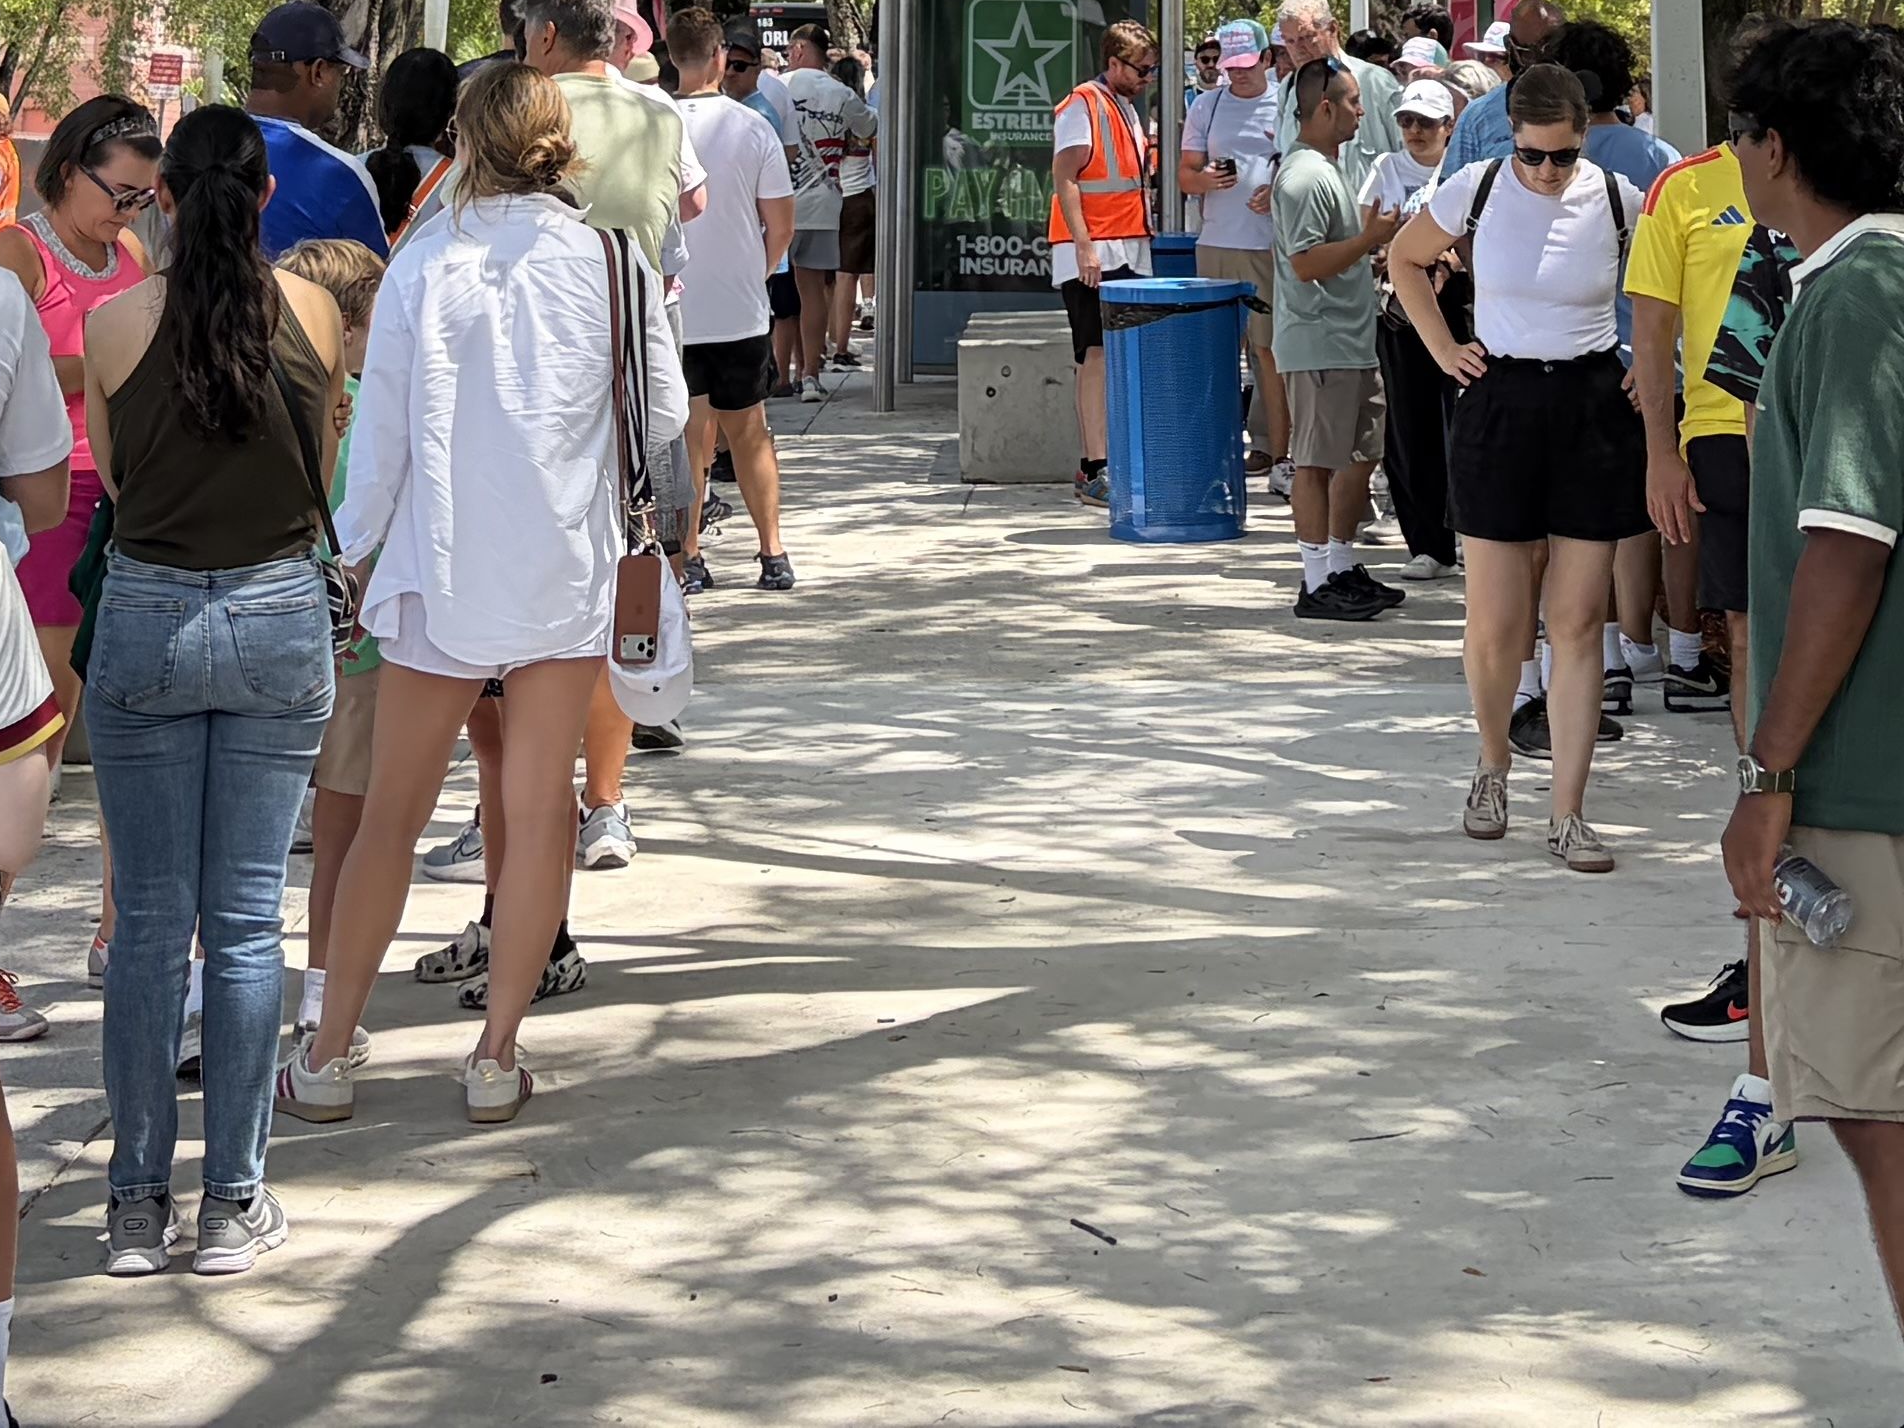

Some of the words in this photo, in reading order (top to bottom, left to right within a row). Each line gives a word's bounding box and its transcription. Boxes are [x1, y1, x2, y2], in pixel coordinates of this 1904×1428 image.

[762, 30, 789, 47] ORL
[971, 112, 1054, 130] ESTRELL
[924, 167, 997, 219] PAY
[957, 235, 1053, 257] 1-800-C
[959, 257, 1052, 276] INSURAN
